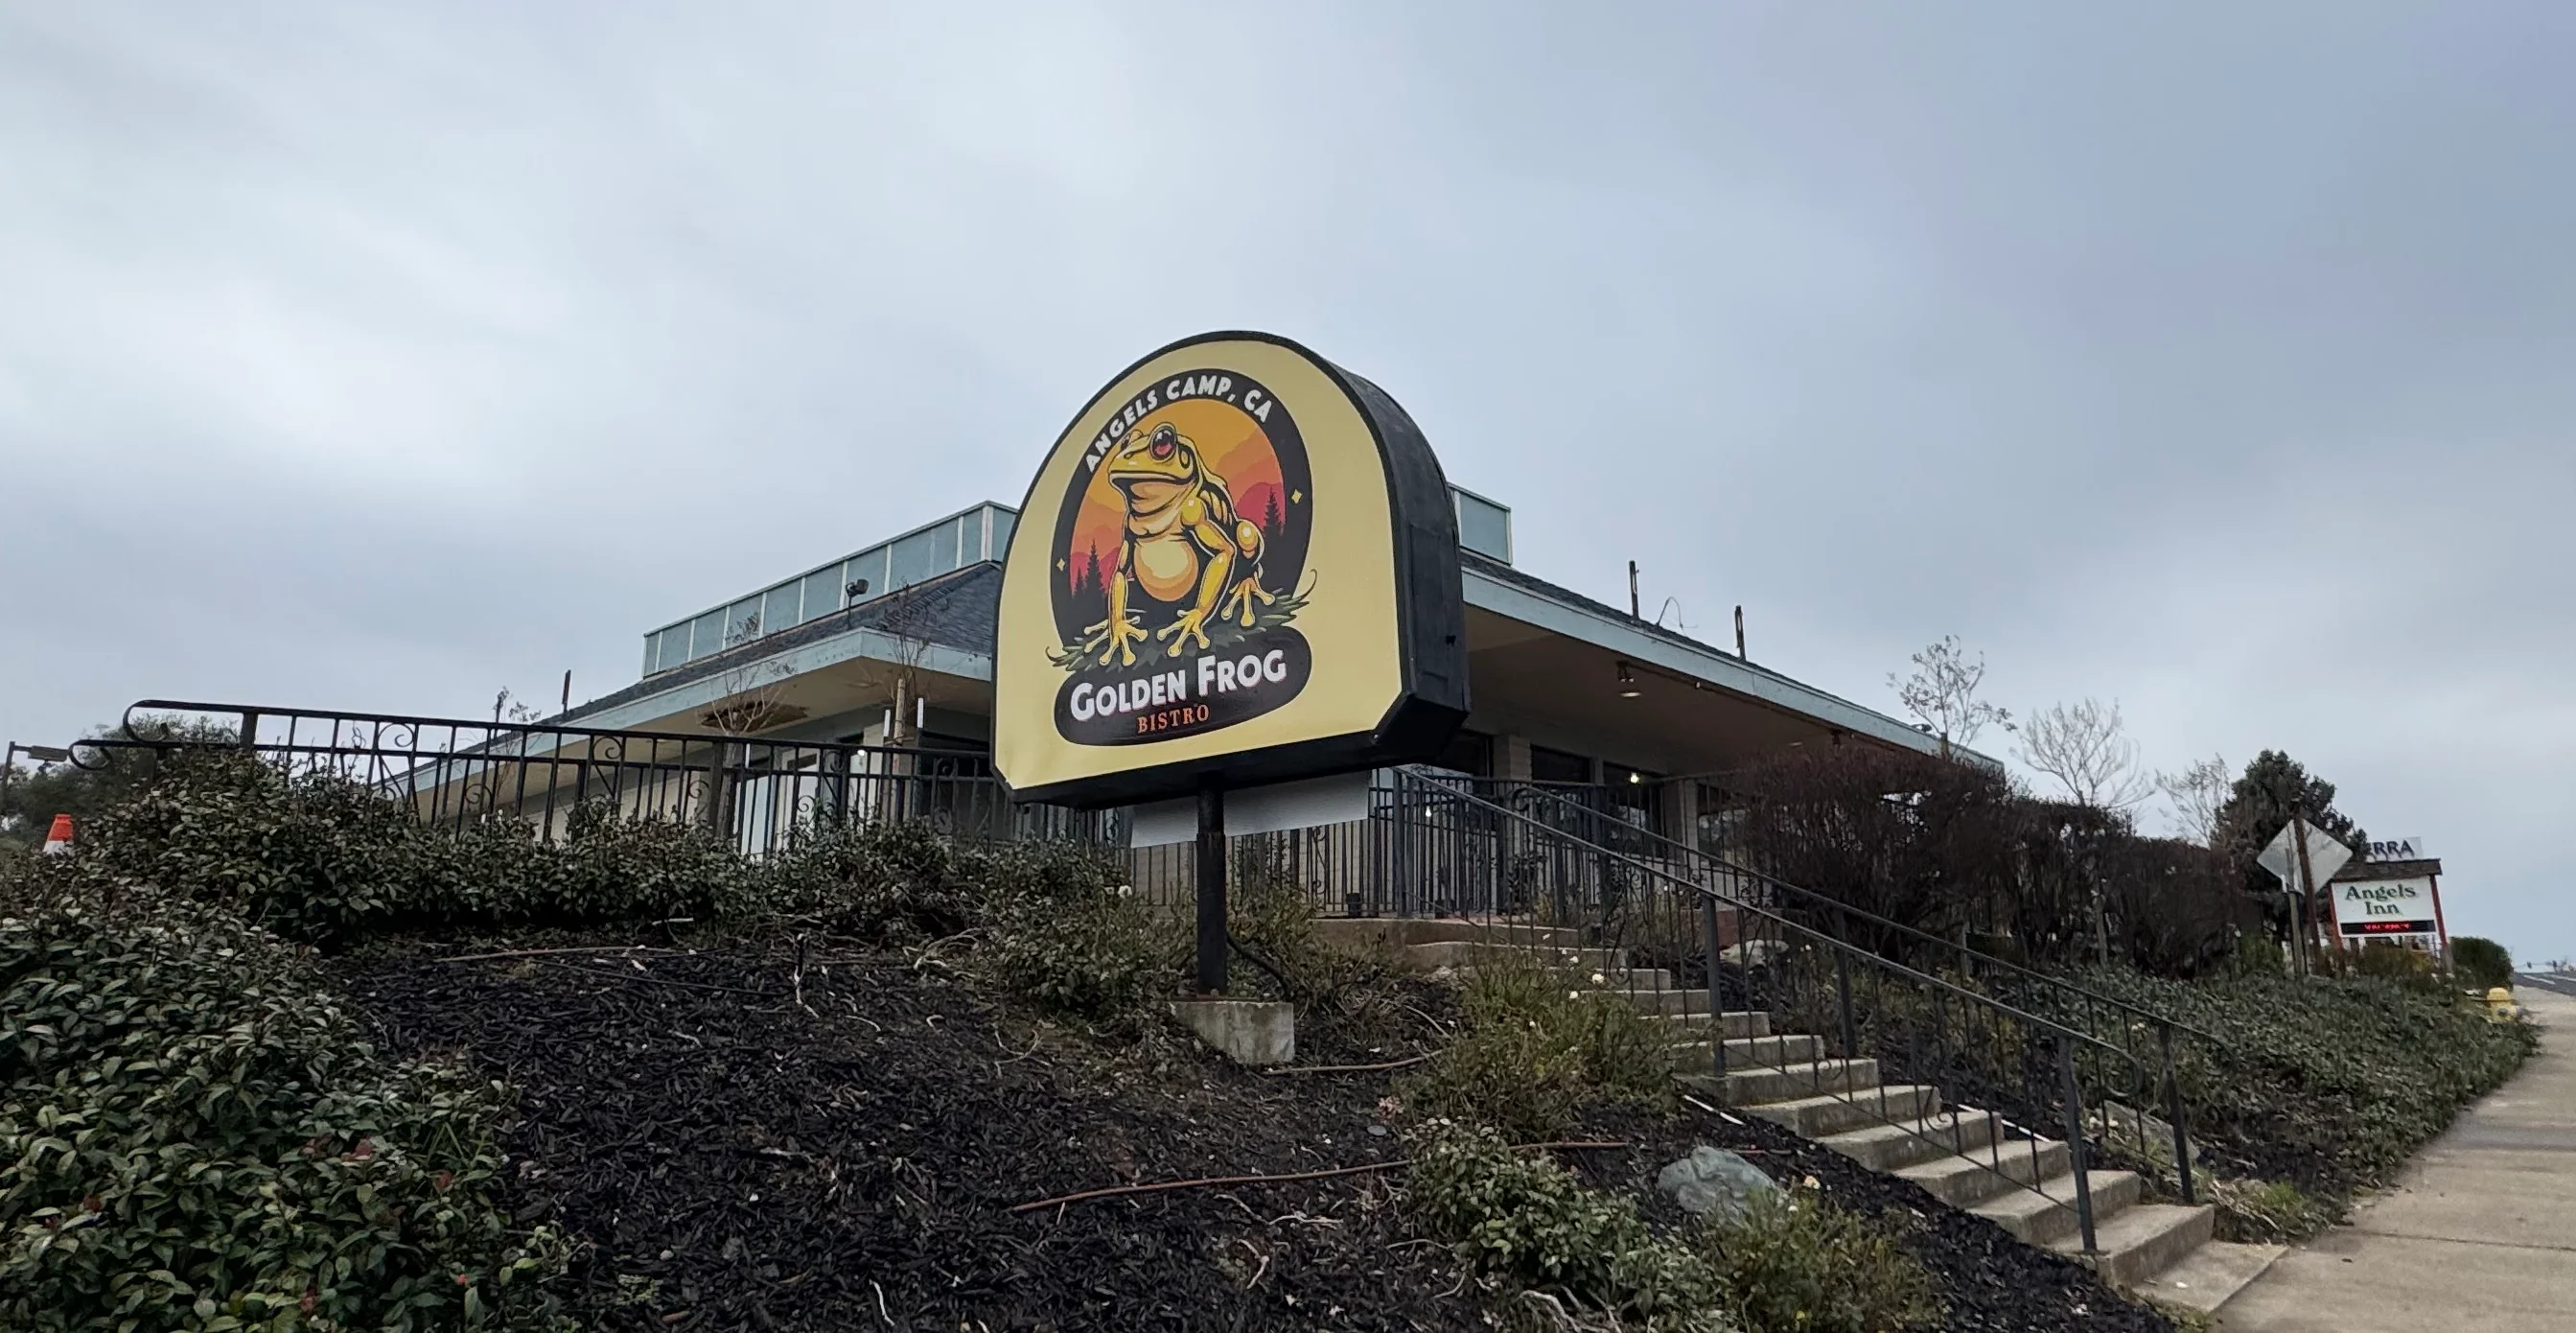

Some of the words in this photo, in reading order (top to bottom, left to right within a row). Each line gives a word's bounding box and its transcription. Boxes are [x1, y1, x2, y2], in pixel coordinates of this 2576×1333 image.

[1085, 389, 1159, 474] ANGELS
[1166, 375, 1236, 403] CAMP,
[1243, 389, 1273, 424] CA
[1070, 669, 1187, 722] GOLDEN
[1197, 649, 1288, 698] FROG
[1137, 704, 1211, 735] BISTRO
[2369, 838, 2415, 862] RRA
[2345, 882, 2418, 902] Angels
[2364, 900, 2403, 916] Inn
